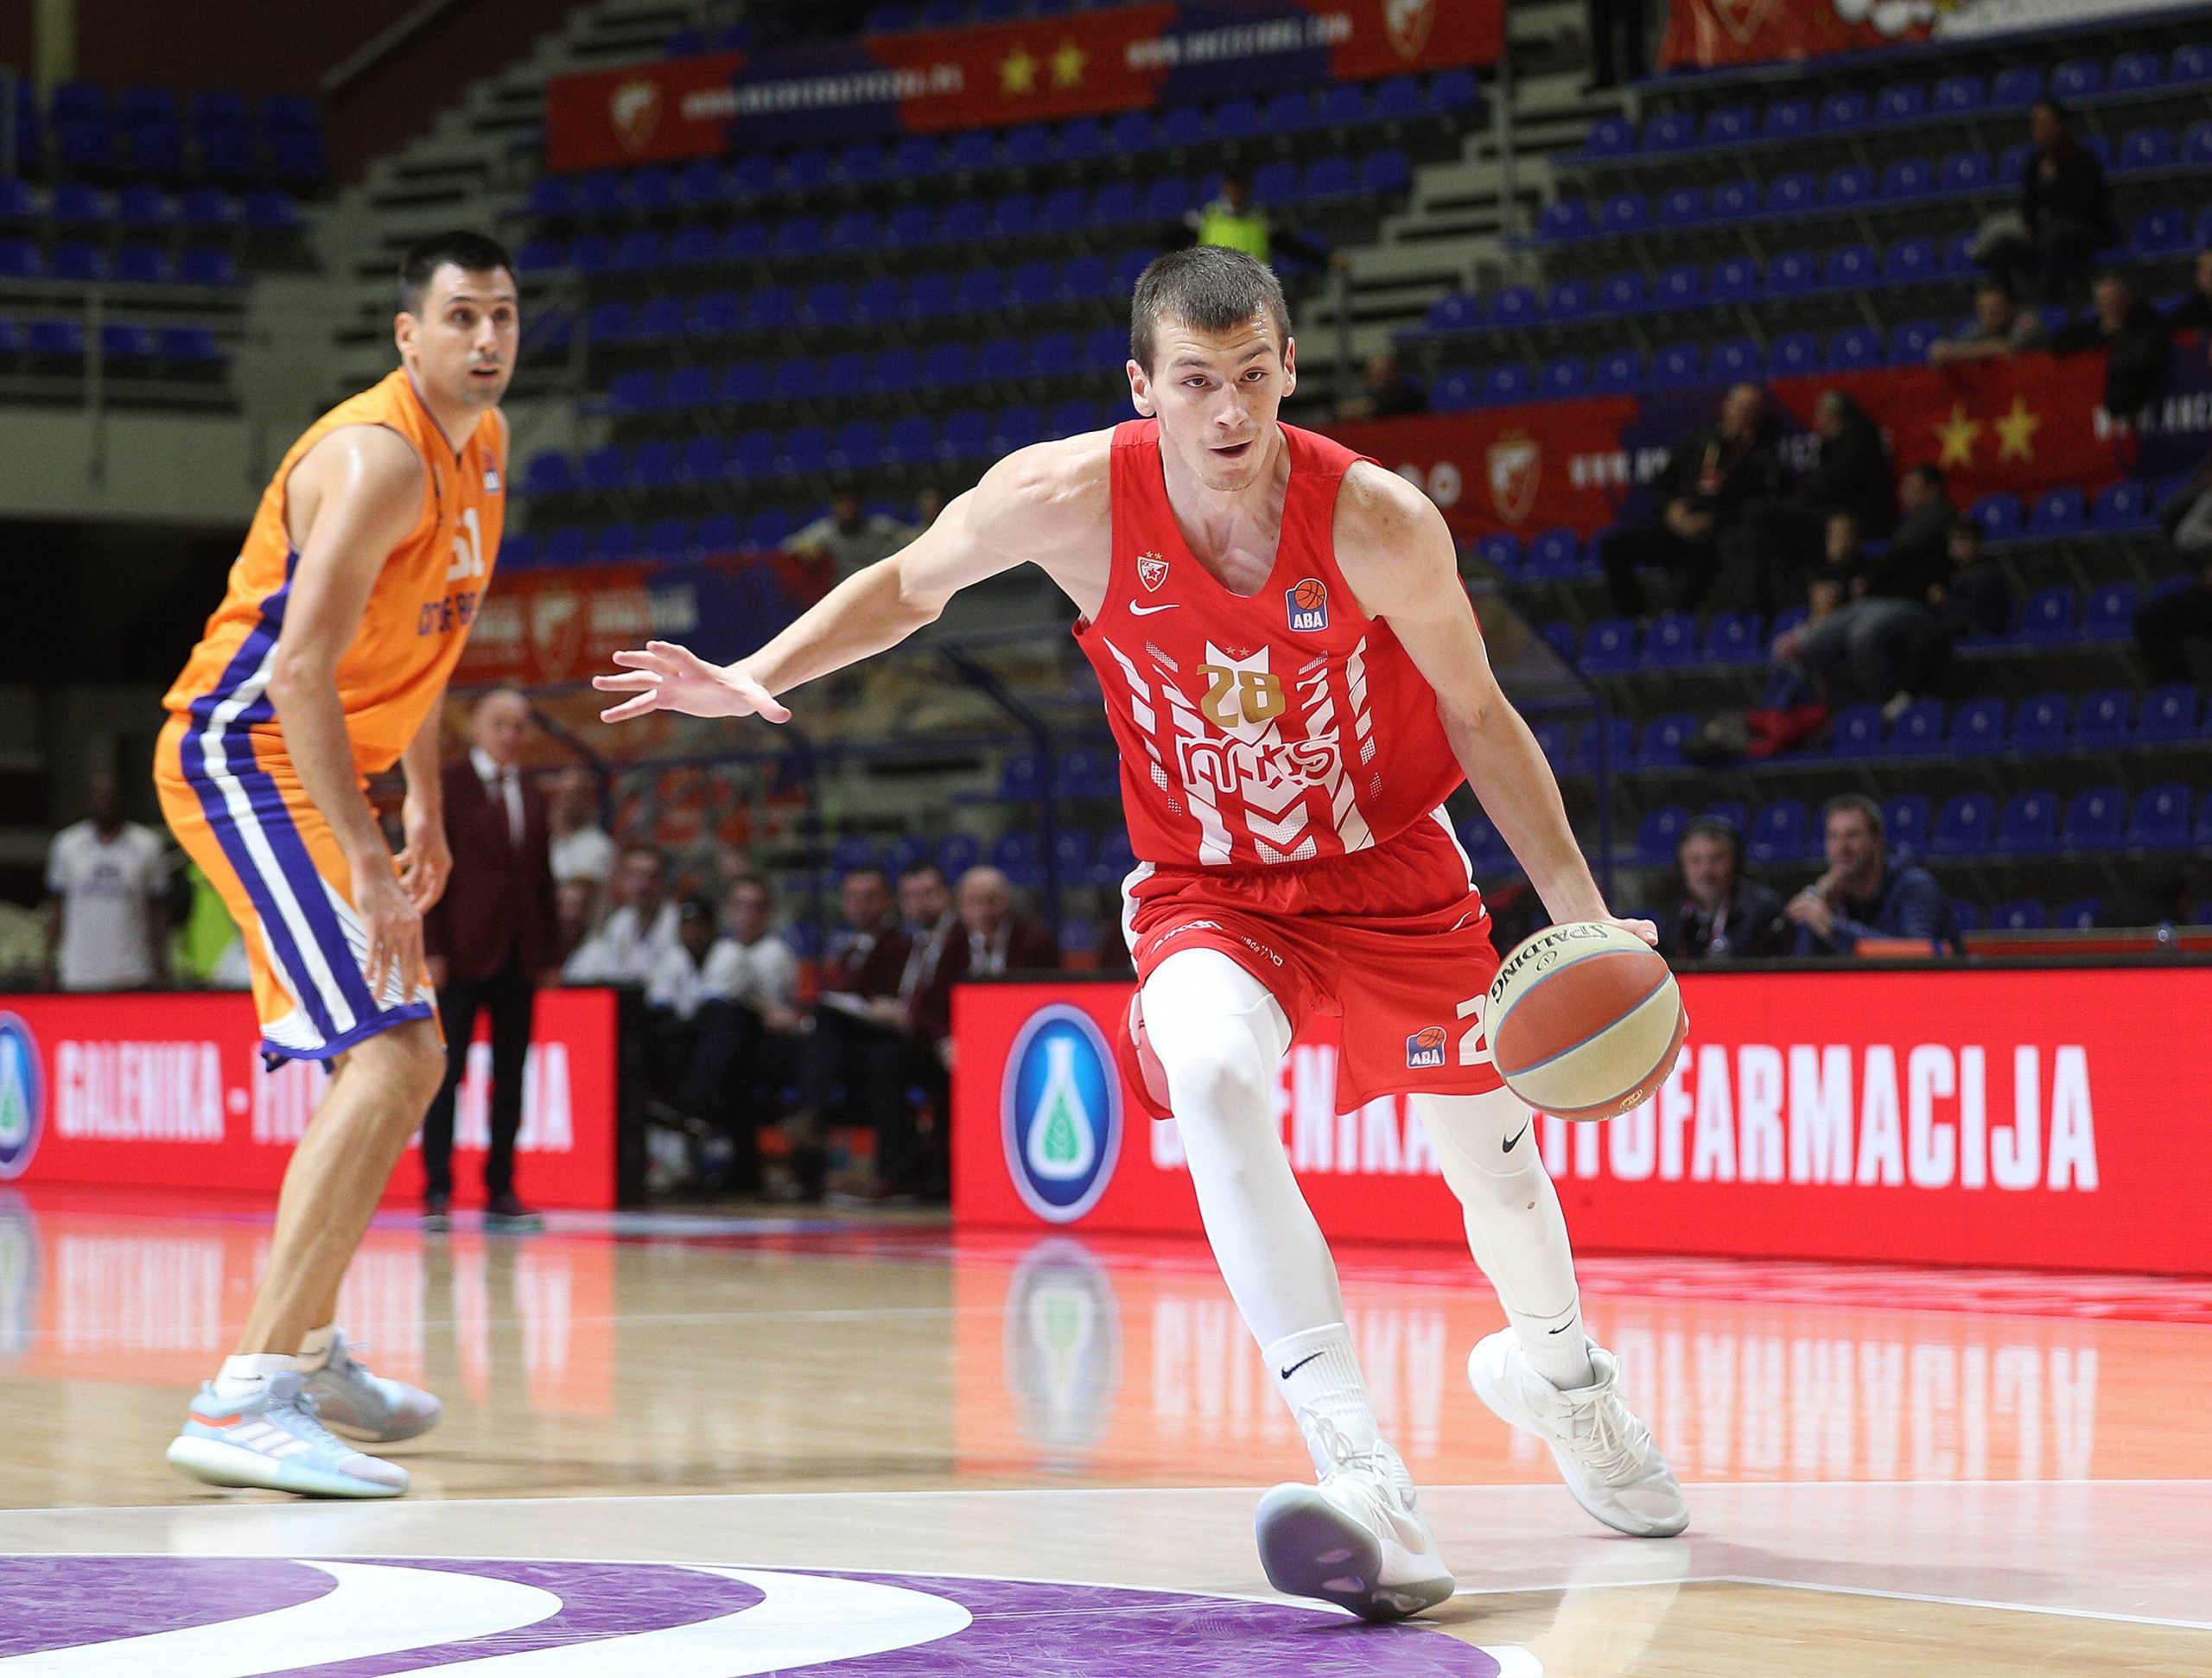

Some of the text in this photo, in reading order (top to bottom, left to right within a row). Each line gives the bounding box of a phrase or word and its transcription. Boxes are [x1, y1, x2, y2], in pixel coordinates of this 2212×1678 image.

[1294, 611, 1324, 629] ABA
[1197, 664, 1286, 728] 28
[1491, 925, 1610, 1005] SPALDING
[1411, 1049, 1440, 1065] ABA
